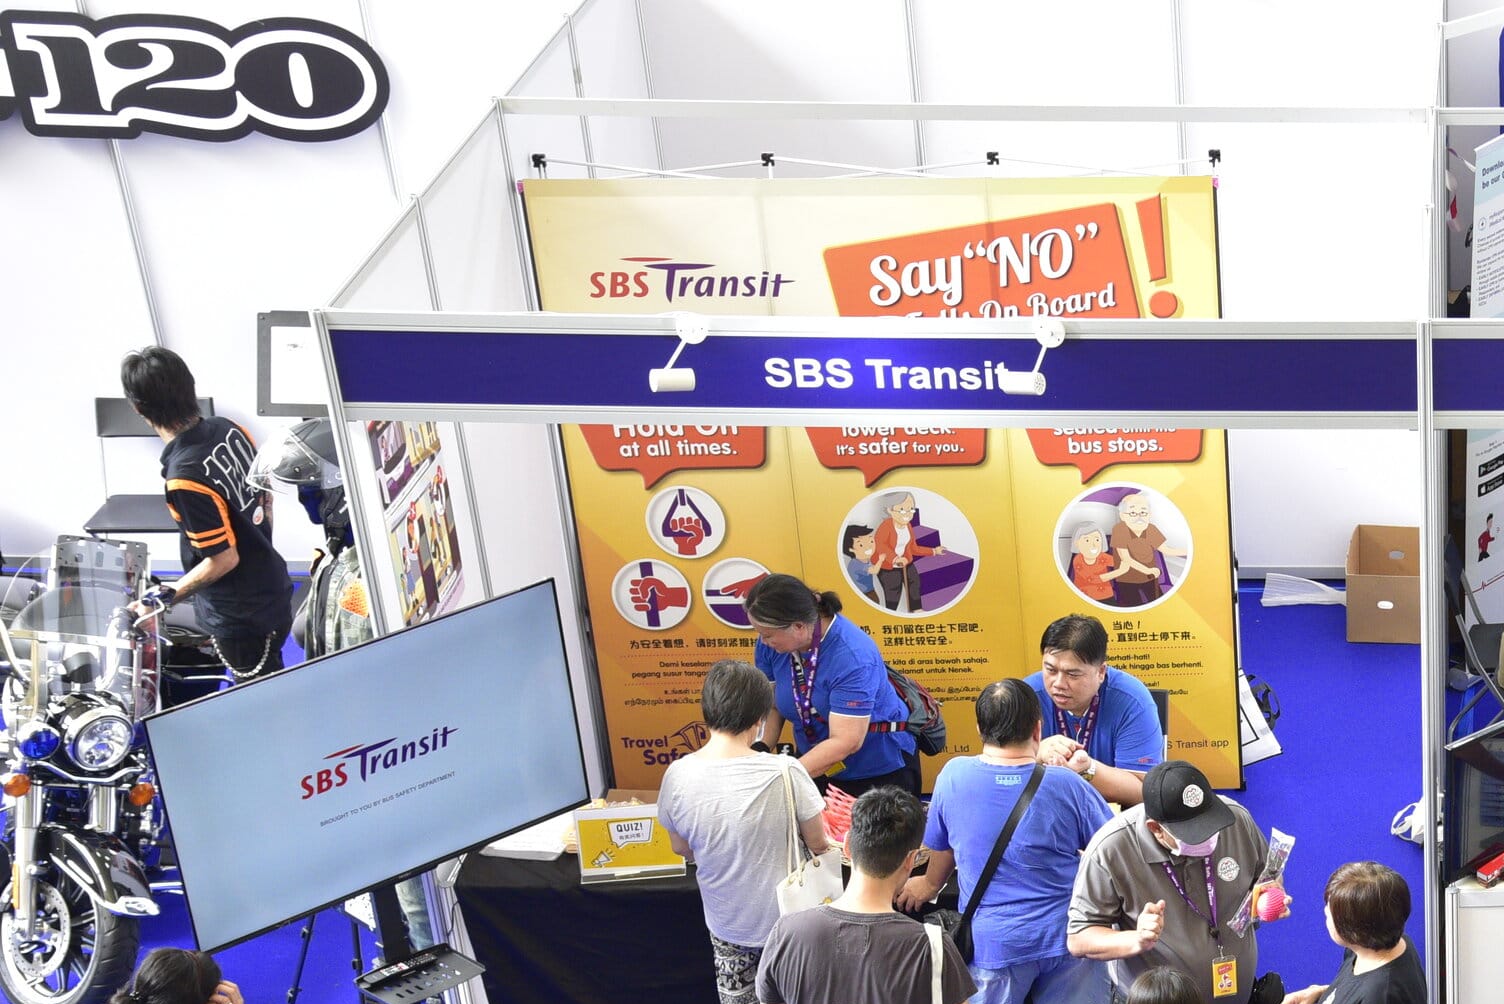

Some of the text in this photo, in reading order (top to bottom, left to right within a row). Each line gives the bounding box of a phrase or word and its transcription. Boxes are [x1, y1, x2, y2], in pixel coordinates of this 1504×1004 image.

[1482, 181, 1489, 189] be
[1491, 174, 1501, 185] our
[590, 263, 796, 303] SBS Transit
[869, 254, 965, 307] Say
[1026, 282, 1116, 317] Board
[764, 357, 1009, 390] SBS Transit
[620, 439, 737, 457] at all times.
[858, 437, 907, 455] safer
[913, 441, 931, 454] for
[935, 443, 965, 456] you.
[1067, 437, 1163, 455] bus stops.
[632, 671, 660, 679] pegang
[1129, 663, 1155, 671] hingga
[621, 735, 668, 748] Travel
[1177, 740, 1208, 749] Transit
[1211, 739, 1229, 751] app
[301, 726, 460, 800] SBS Transit
[320, 771, 455, 827] BROUGHT TO YOU BY BUS SAFETY DEPARTMENT
[616, 822, 642, 832] QUIZ!
